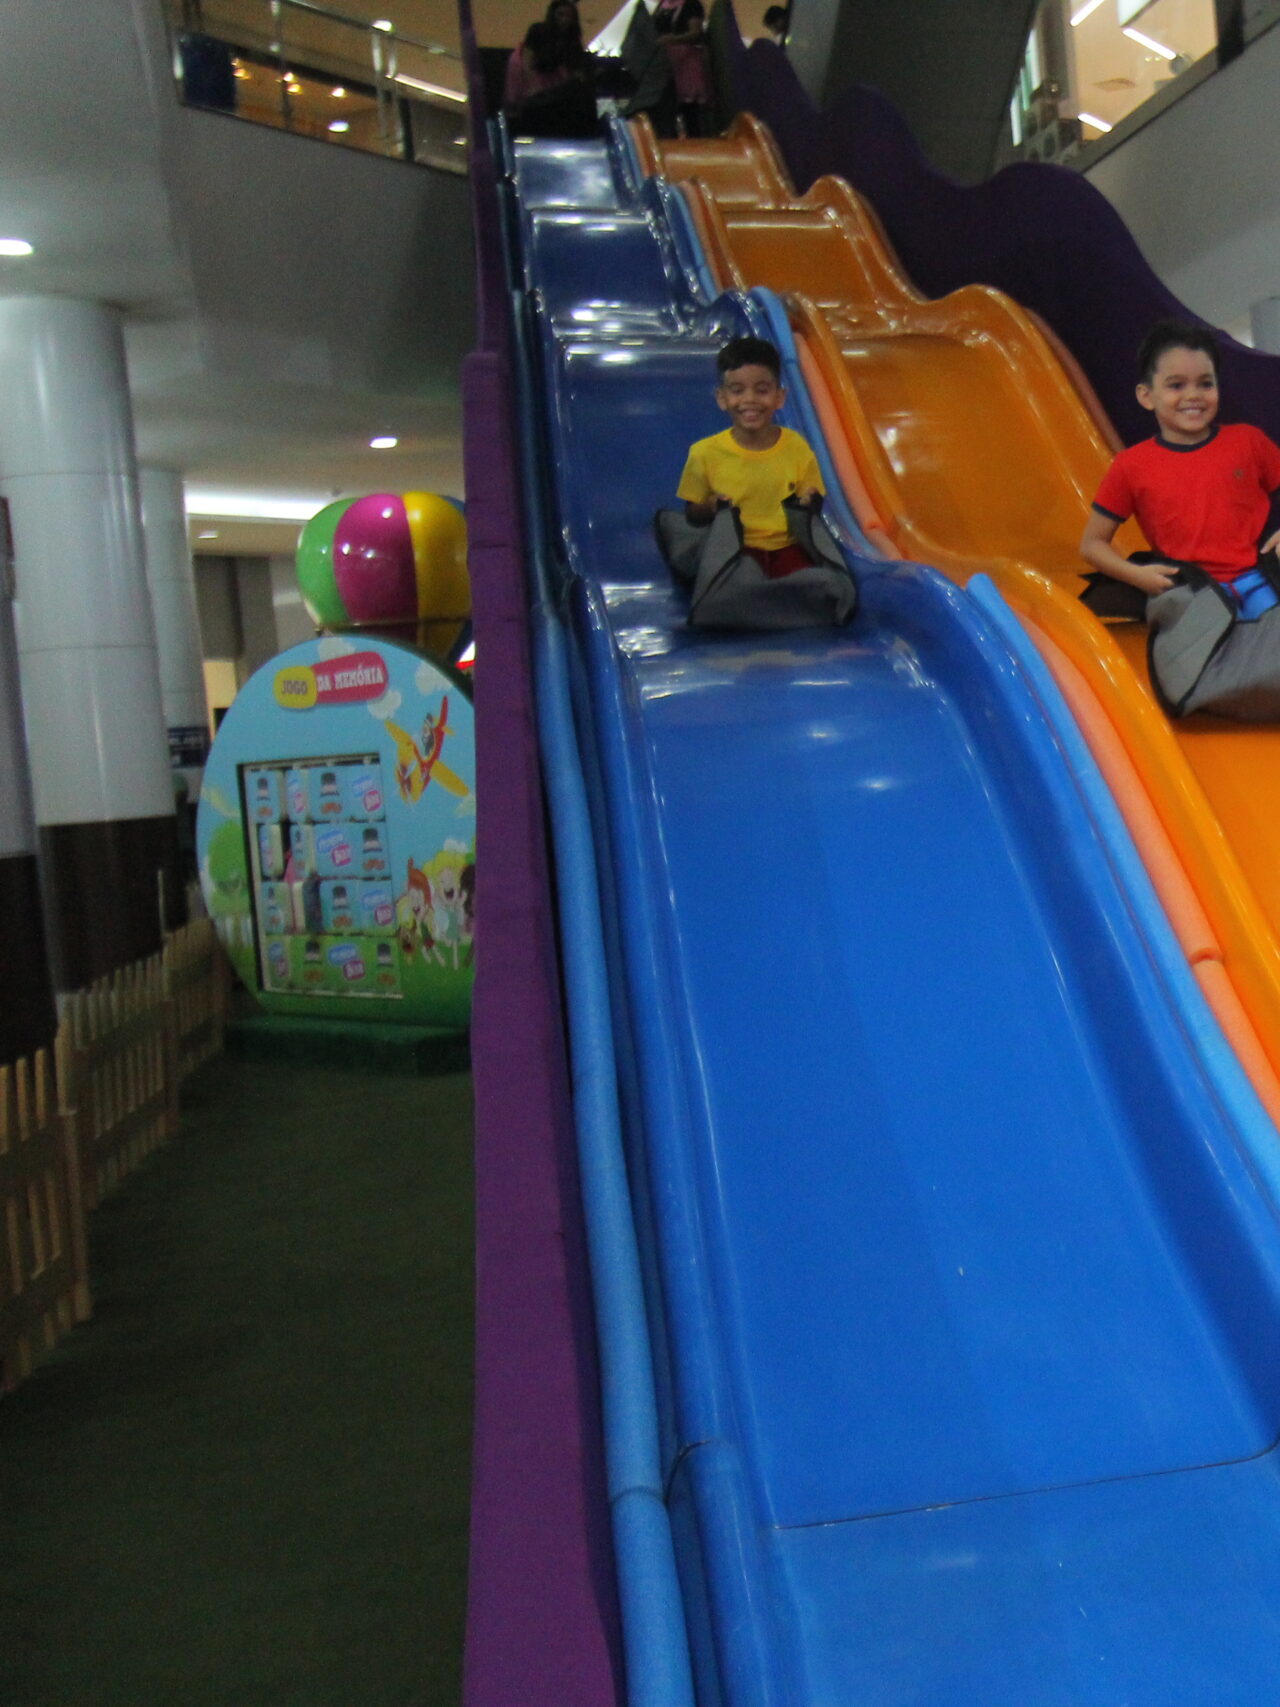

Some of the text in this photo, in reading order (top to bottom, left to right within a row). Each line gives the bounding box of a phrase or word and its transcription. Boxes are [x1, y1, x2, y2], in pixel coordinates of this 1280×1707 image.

[282, 664, 384, 696] JOGO DA MEMÓRIA
